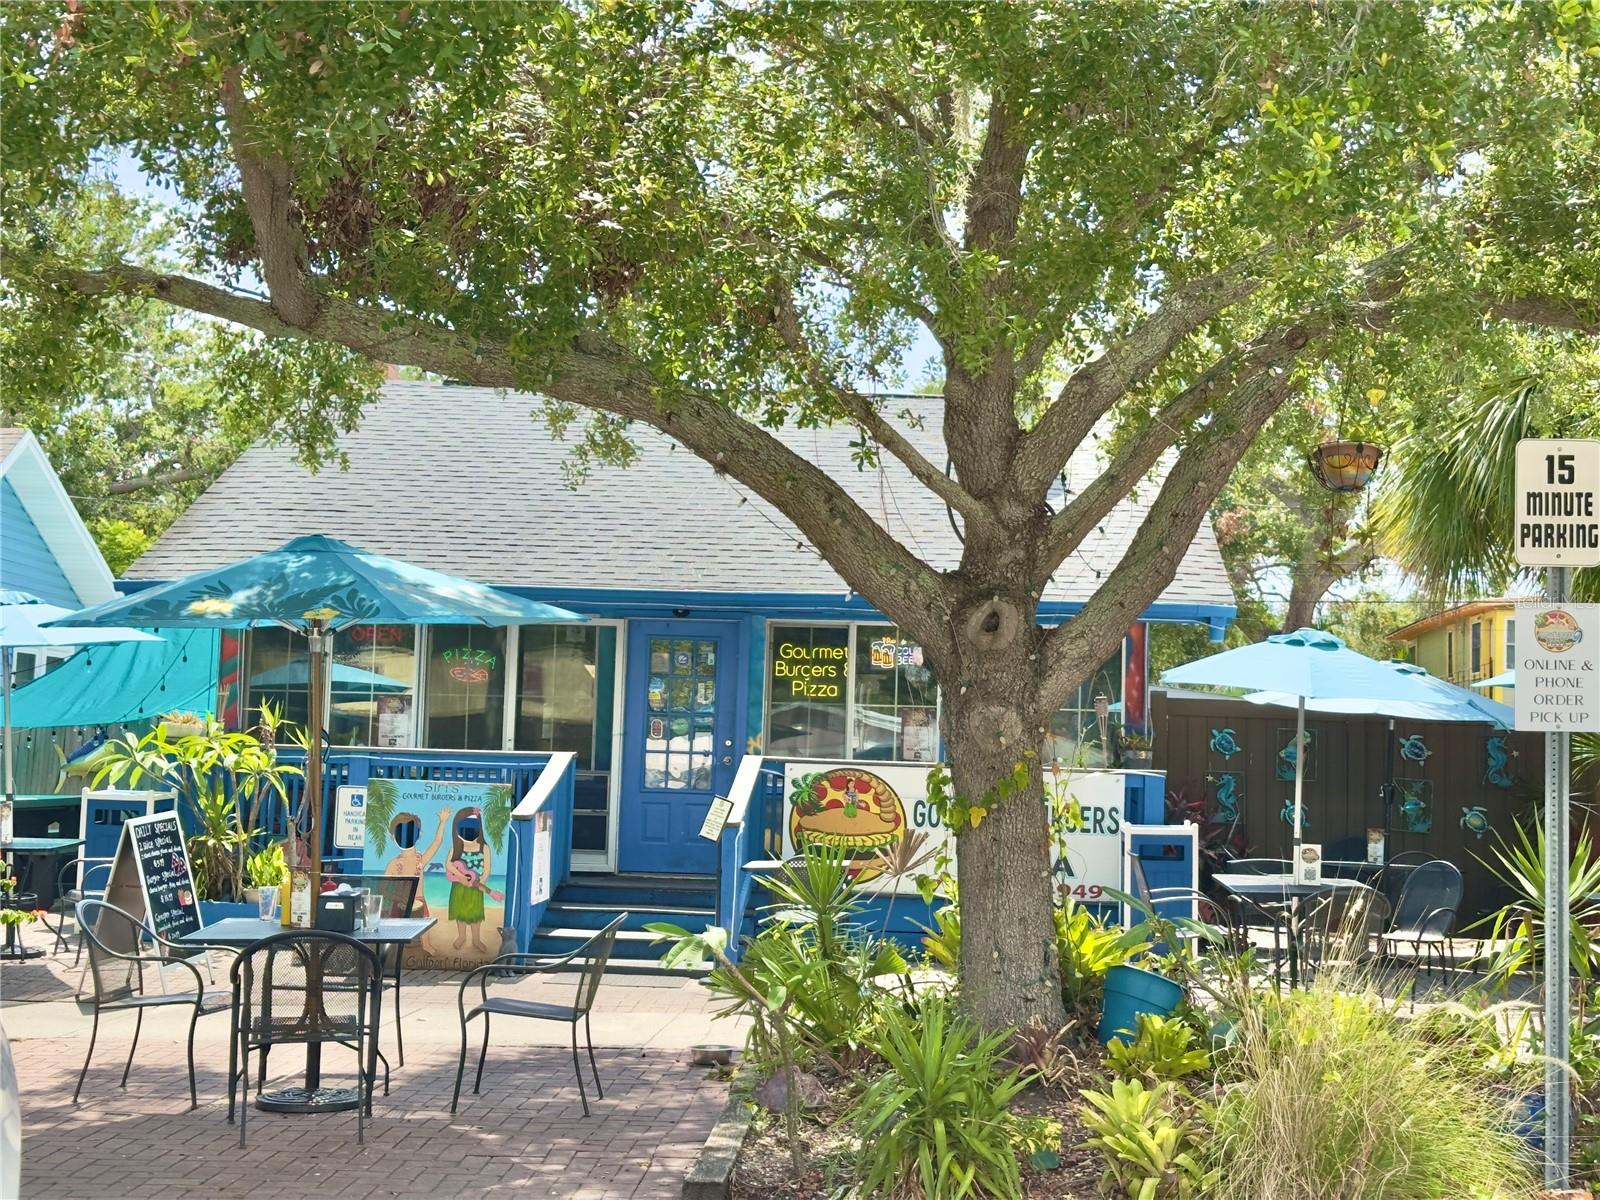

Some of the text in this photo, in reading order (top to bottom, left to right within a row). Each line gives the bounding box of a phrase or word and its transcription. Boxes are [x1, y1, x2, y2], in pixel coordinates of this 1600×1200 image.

[1545, 454, 1575, 485] 15
[1526, 491, 1593, 517] MINUTE
[1520, 523, 1599, 549] PARKING
[351, 627, 402, 641] OPEN
[779, 643, 849, 660] Gourmet
[897, 646, 915, 655] COL
[443, 648, 497, 669] PIZZA
[897, 656, 915, 665] BEE
[1524, 659, 1594, 671] ONLINE &
[775, 660, 837, 680] Burgers
[792, 680, 838, 697] Pizza
[1535, 676, 1584, 688] PHONE
[1533, 694, 1584, 706] ORDER
[1530, 711, 1589, 723] PICK UP
[402, 792, 428, 801] GOURMET
[464, 794, 483, 802] PIZZA
[135, 820, 177, 839] DAILY SPECIALS
